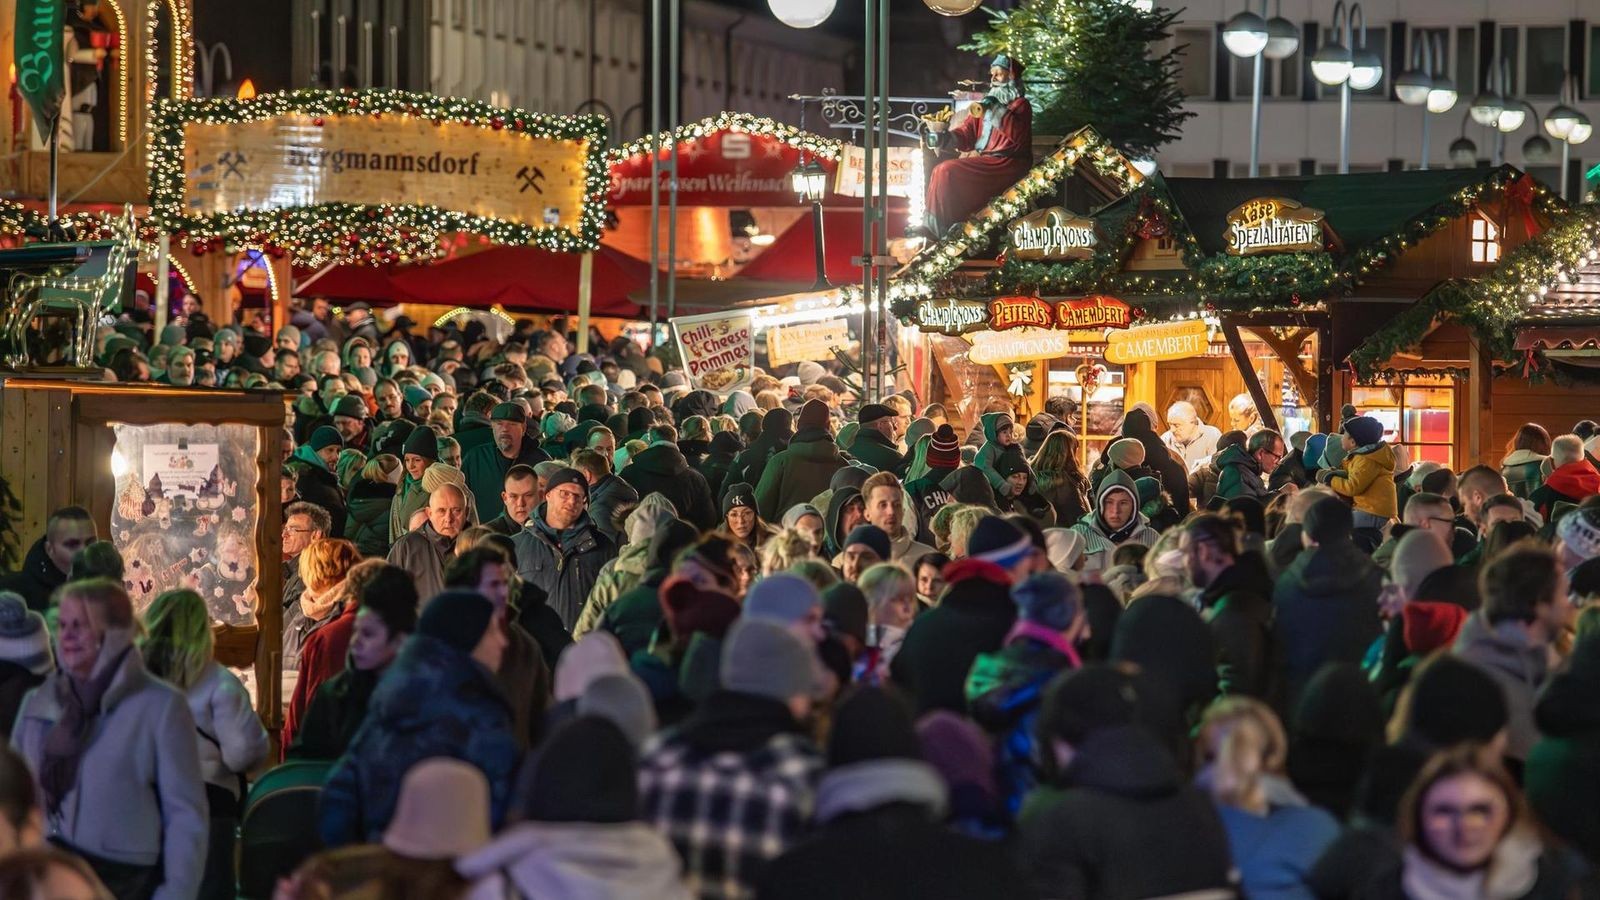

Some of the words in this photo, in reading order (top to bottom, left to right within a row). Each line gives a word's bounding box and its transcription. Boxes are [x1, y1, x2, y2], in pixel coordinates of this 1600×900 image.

[20, 0, 54, 93] Bau
[288, 145, 481, 175] Bergmannsdorf
[1058, 298, 1125, 326] CAMEMBERT
[681, 324, 715, 345] Chili-
[703, 329, 748, 353] Cheese
[1116, 335, 1200, 360] CAMEMBERT
[689, 345, 749, 376] Pommes
[979, 337, 1064, 360] CHAMPIGNONS
